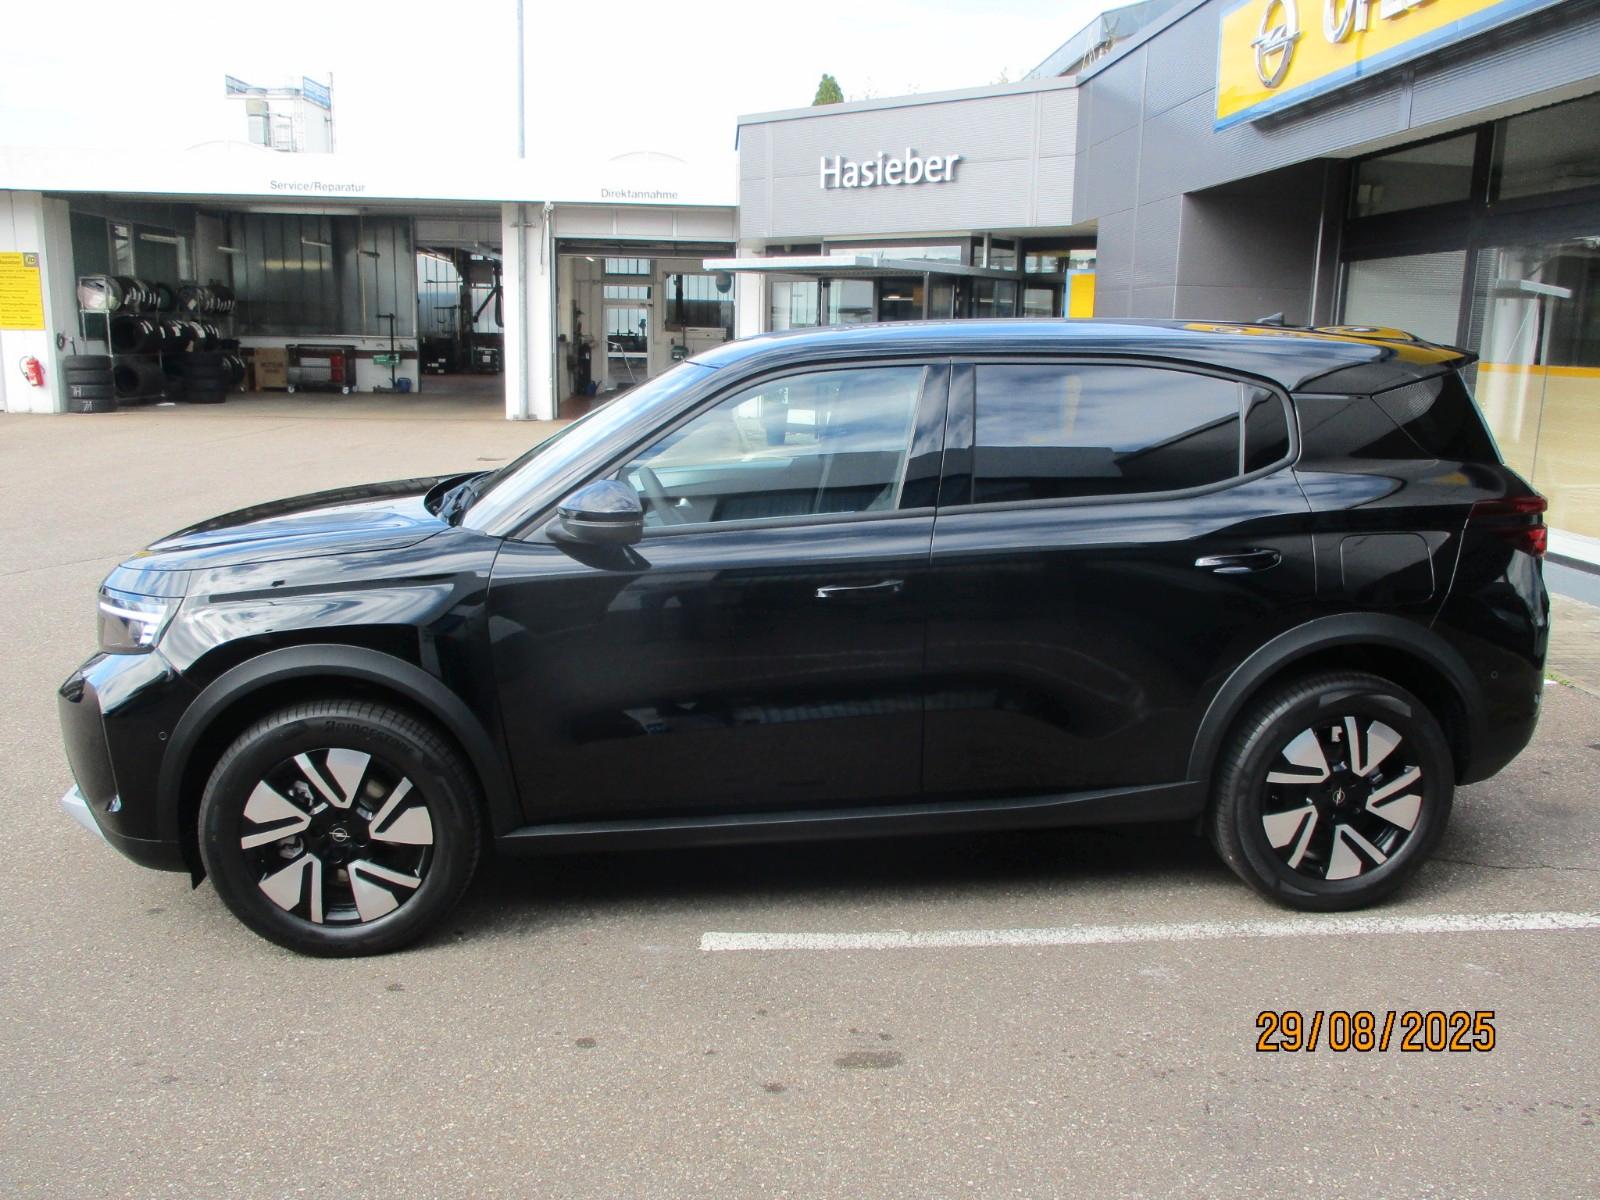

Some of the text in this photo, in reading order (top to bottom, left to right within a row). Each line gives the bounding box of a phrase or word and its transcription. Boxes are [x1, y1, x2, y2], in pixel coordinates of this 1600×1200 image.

[819, 147, 960, 189] Hasieber
[270, 180, 366, 193] Service/Reparatur
[600, 188, 679, 200] Direktannahme
